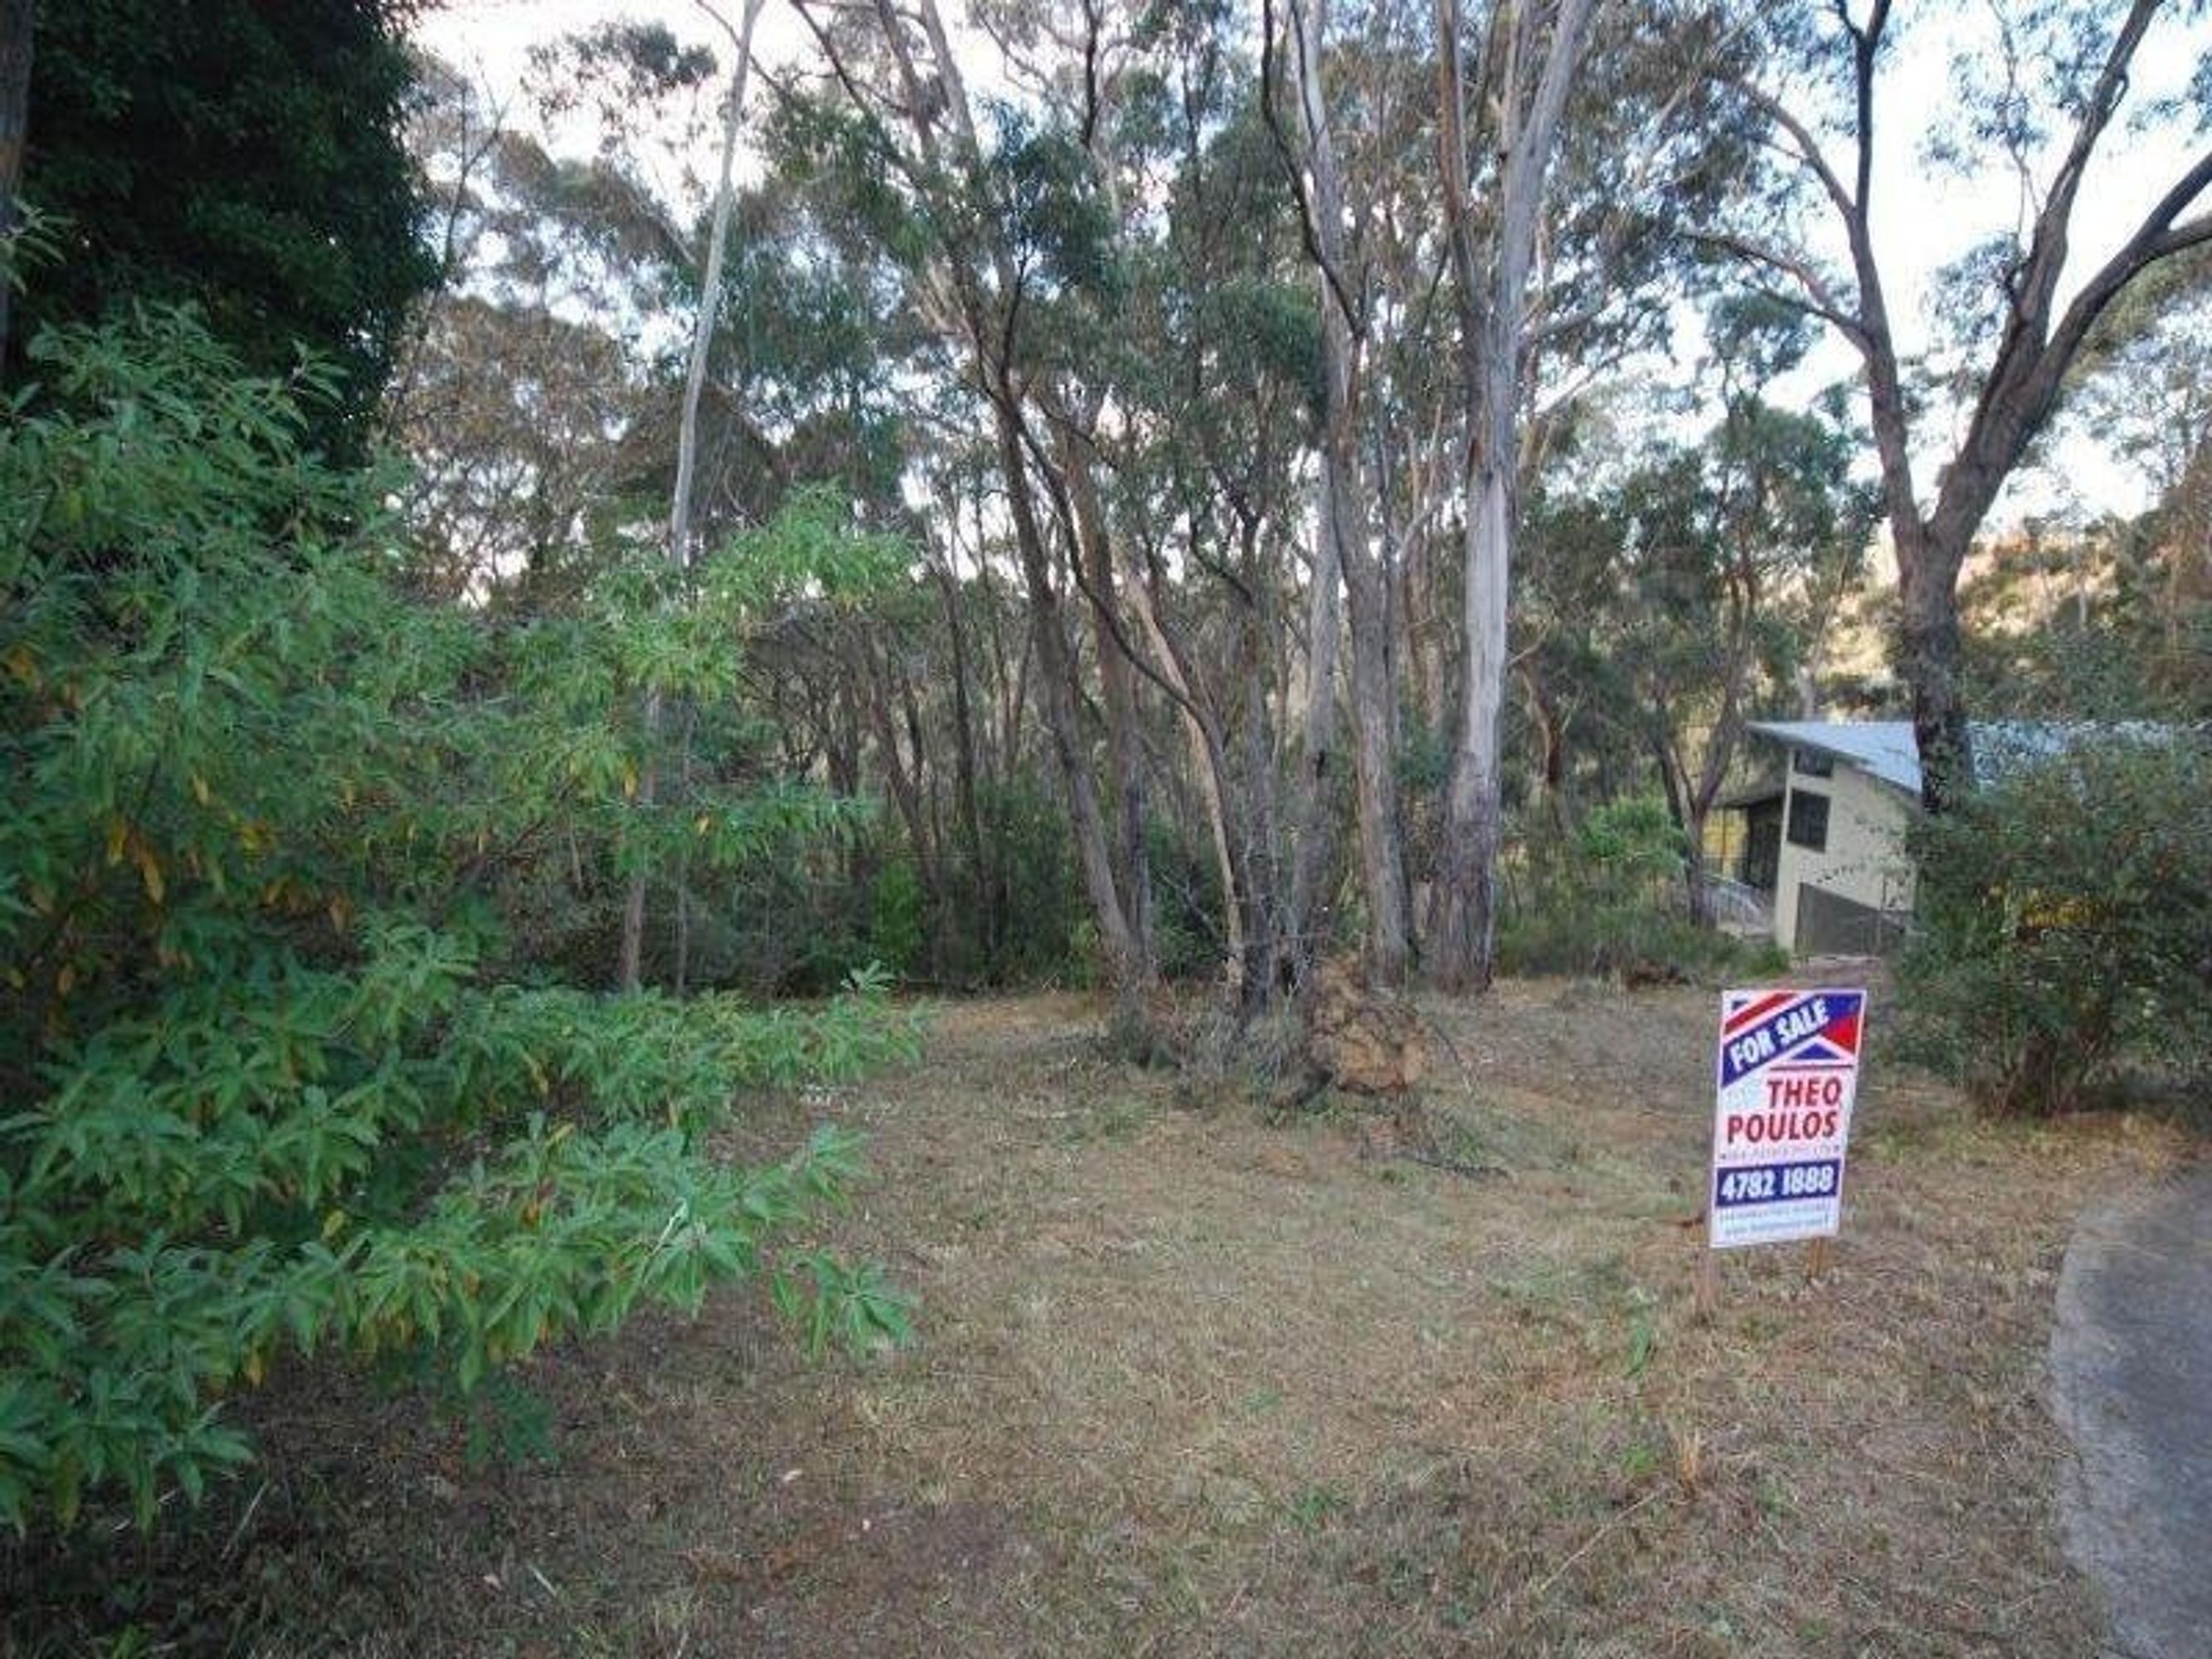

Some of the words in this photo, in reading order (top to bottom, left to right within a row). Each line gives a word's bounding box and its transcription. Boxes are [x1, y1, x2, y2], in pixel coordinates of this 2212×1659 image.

[1729, 1029, 1776, 1073] FOR
[1775, 999, 1830, 1045] SALE
[1767, 1078, 1841, 1108] THEO
[1727, 1112, 1837, 1143] POULOS
[1721, 1170, 1775, 1200] 4782
[1781, 1165, 1834, 1196] 1888
